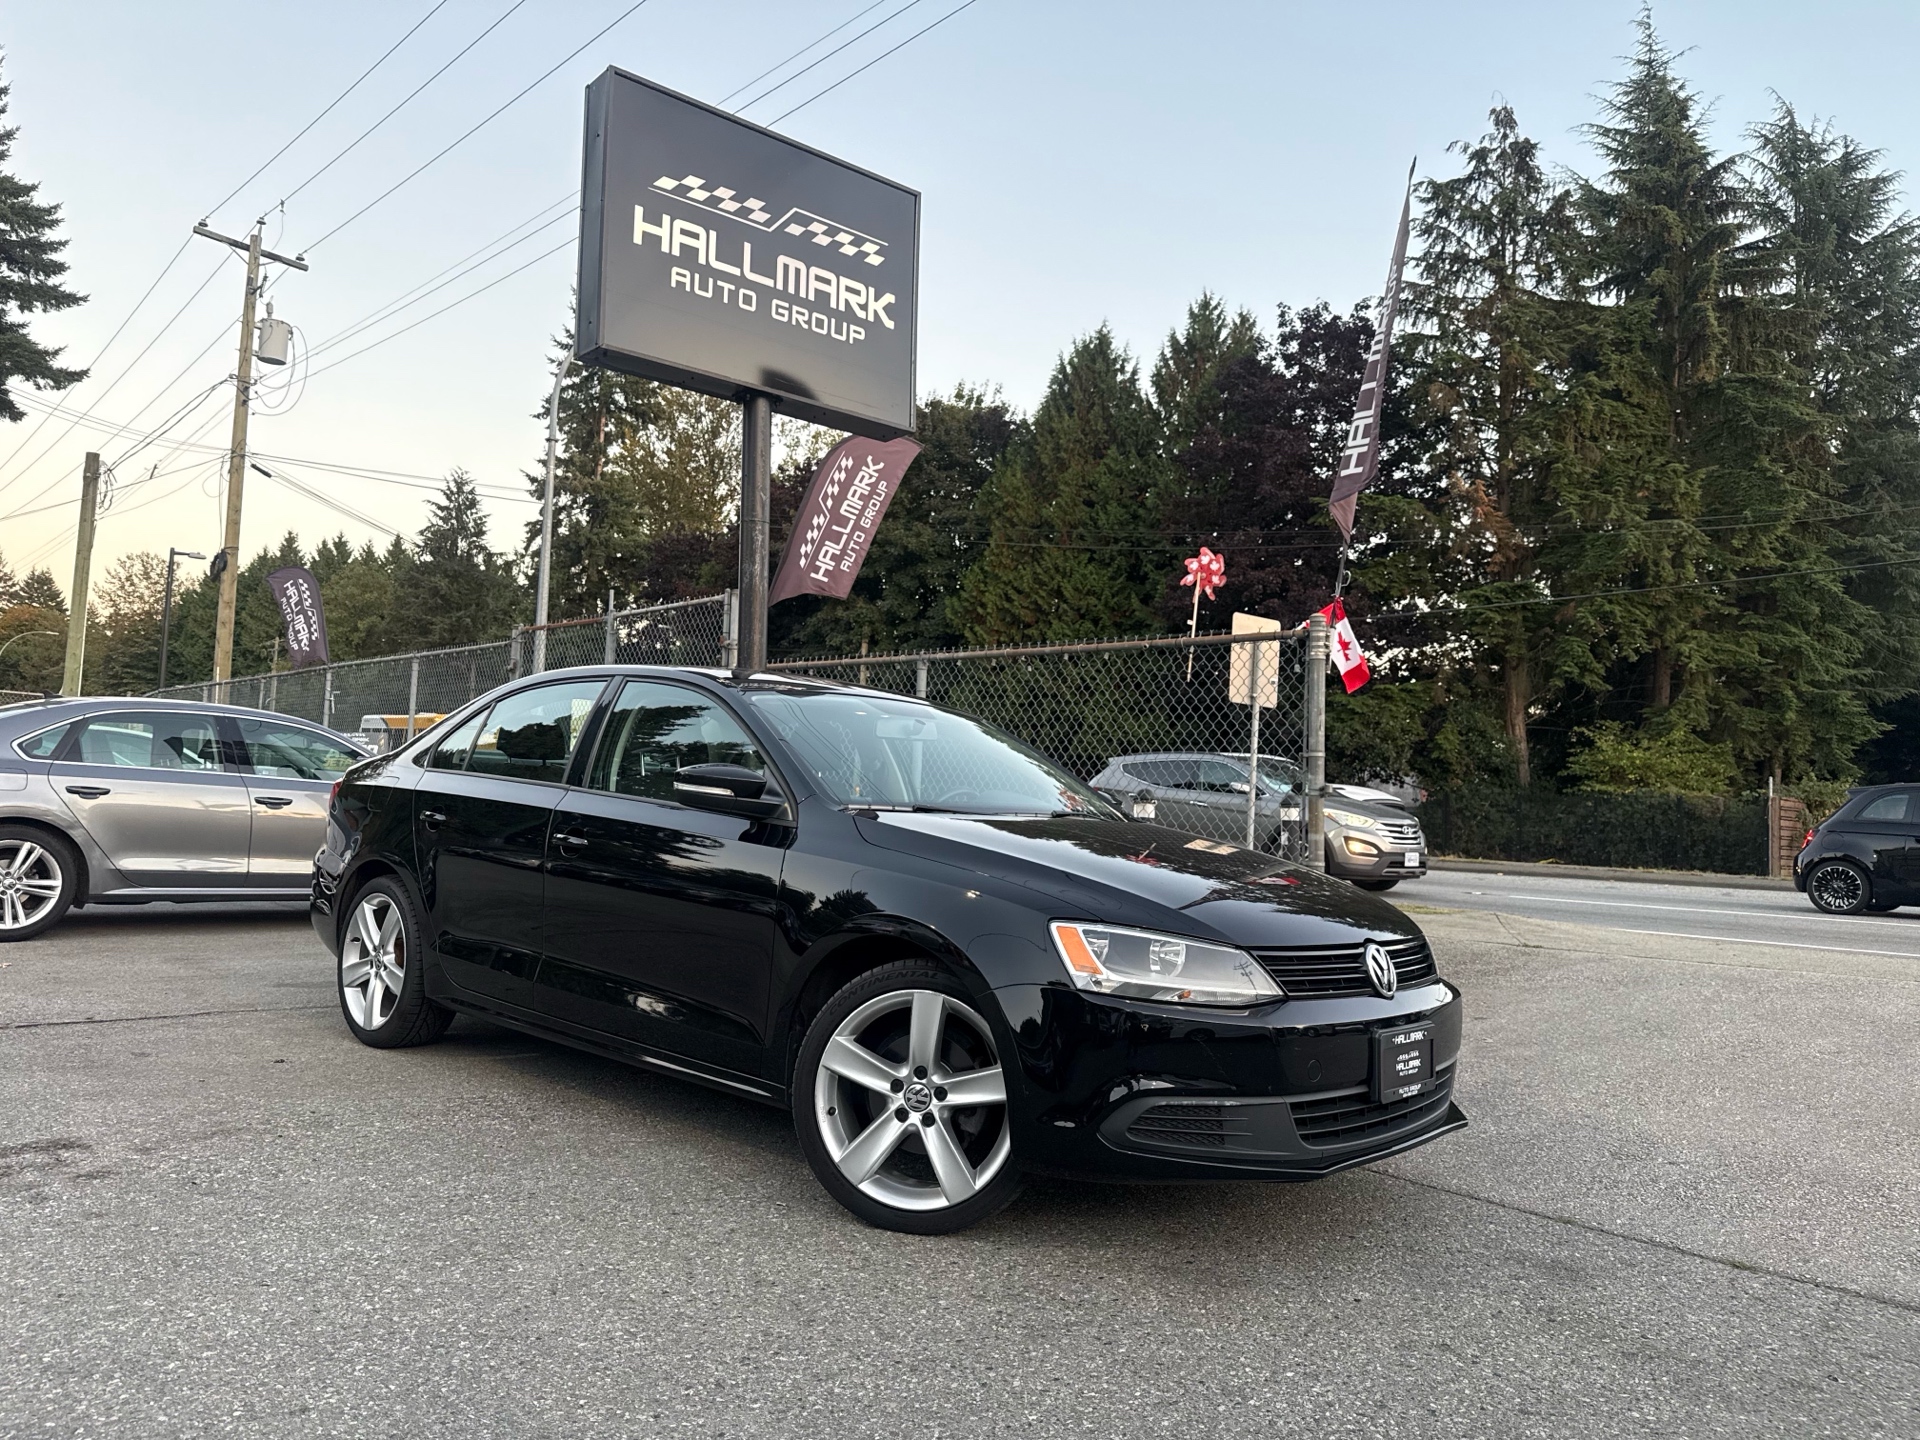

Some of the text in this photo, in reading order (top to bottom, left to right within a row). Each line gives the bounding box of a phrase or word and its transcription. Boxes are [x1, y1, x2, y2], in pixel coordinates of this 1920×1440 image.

[632, 204, 896, 330] HALLMARK
[670, 266, 865, 344] AUTO GROUP
[810, 455, 885, 583] HALLMARK
[839, 480, 888, 572] AUTO GROUP
[283, 580, 310, 652] HALLMARK
[829, 970, 940, 1016] CONTINENTAL
[1394, 1030, 1425, 1045] HALLMARK
